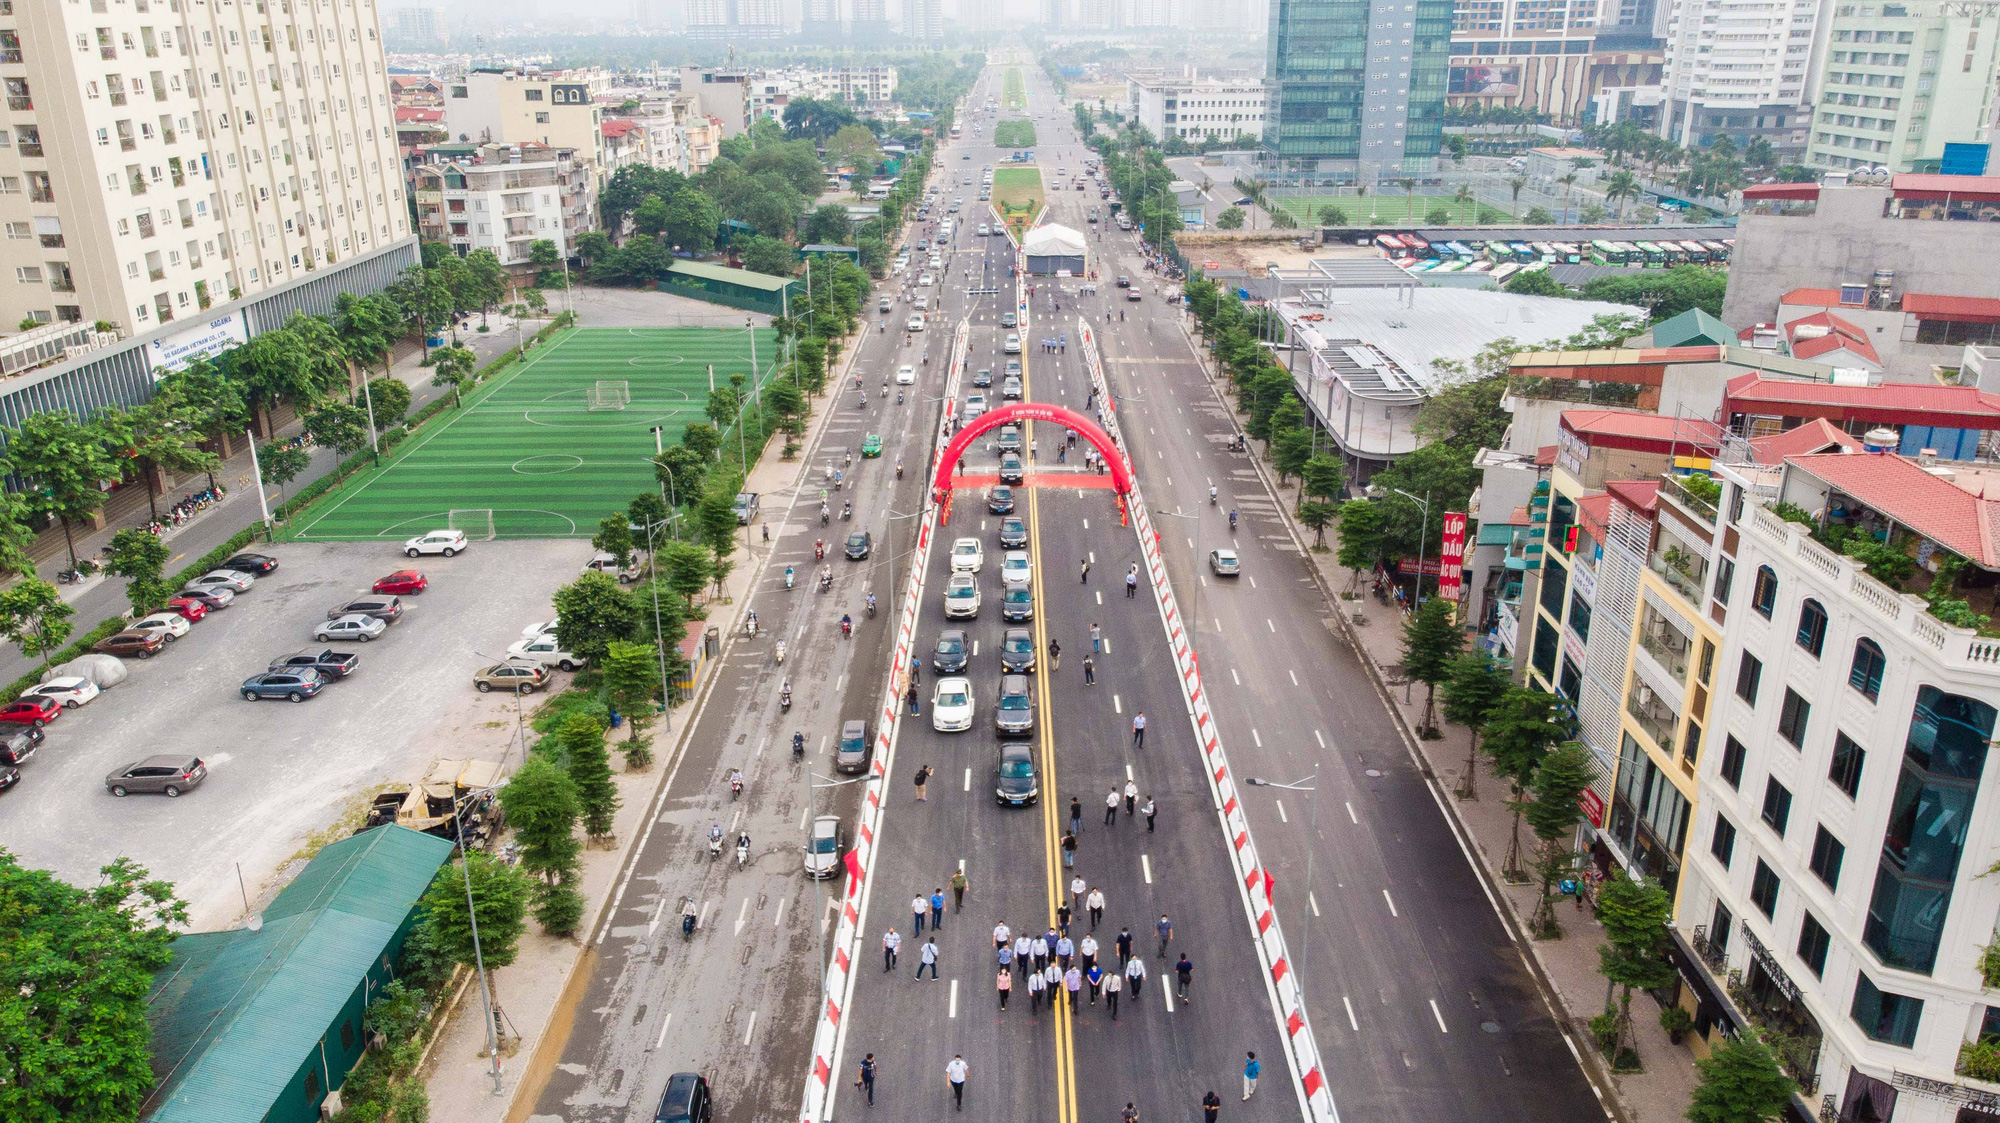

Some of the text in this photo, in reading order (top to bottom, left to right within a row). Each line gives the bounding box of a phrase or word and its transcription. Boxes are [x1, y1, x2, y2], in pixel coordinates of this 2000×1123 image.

[210, 316, 232, 329] SAGAWA
[164, 352, 171, 360] SG
[171, 345, 189, 356] SAGAWA
[189, 337, 209, 349] VIETNAM
[1445, 516, 1464, 535] LỐP
[1449, 564, 1461, 579] QUY
[1901, 1075, 1954, 1097] DING
